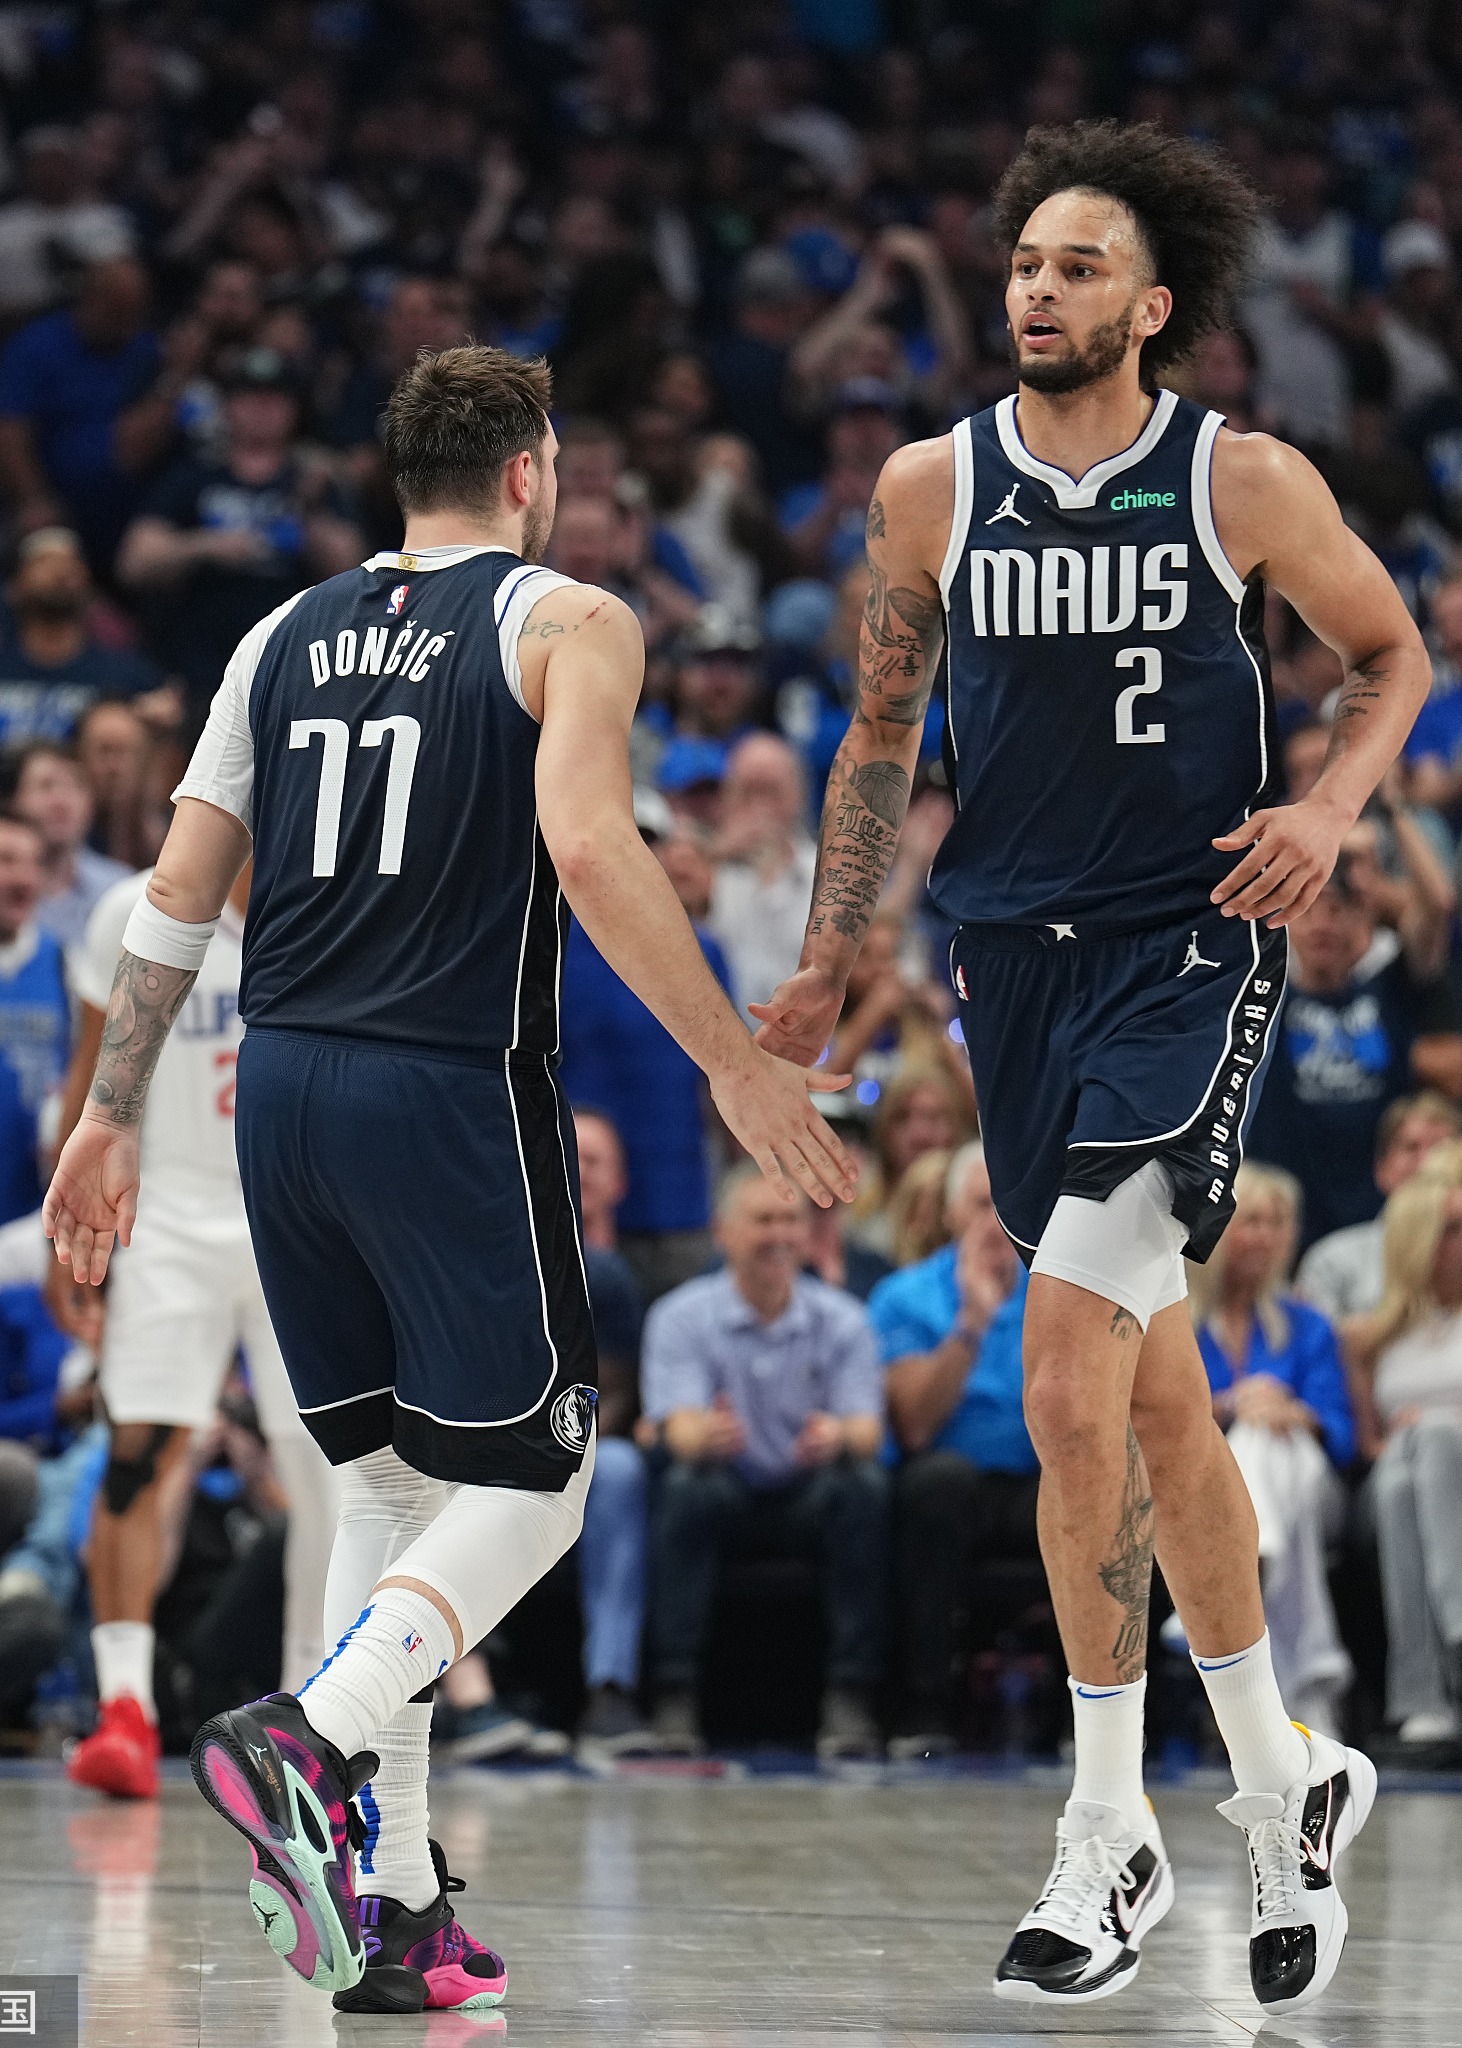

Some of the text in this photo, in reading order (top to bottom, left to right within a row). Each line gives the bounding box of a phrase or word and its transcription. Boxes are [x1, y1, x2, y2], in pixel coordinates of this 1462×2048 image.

[1110, 488, 1176, 511] chime
[970, 543, 1188, 637] MAVS
[308, 620, 456, 689] DONČIĆ
[1114, 646, 1166, 744] 2
[288, 714, 422, 878] 77
[834, 802, 885, 842] Life
